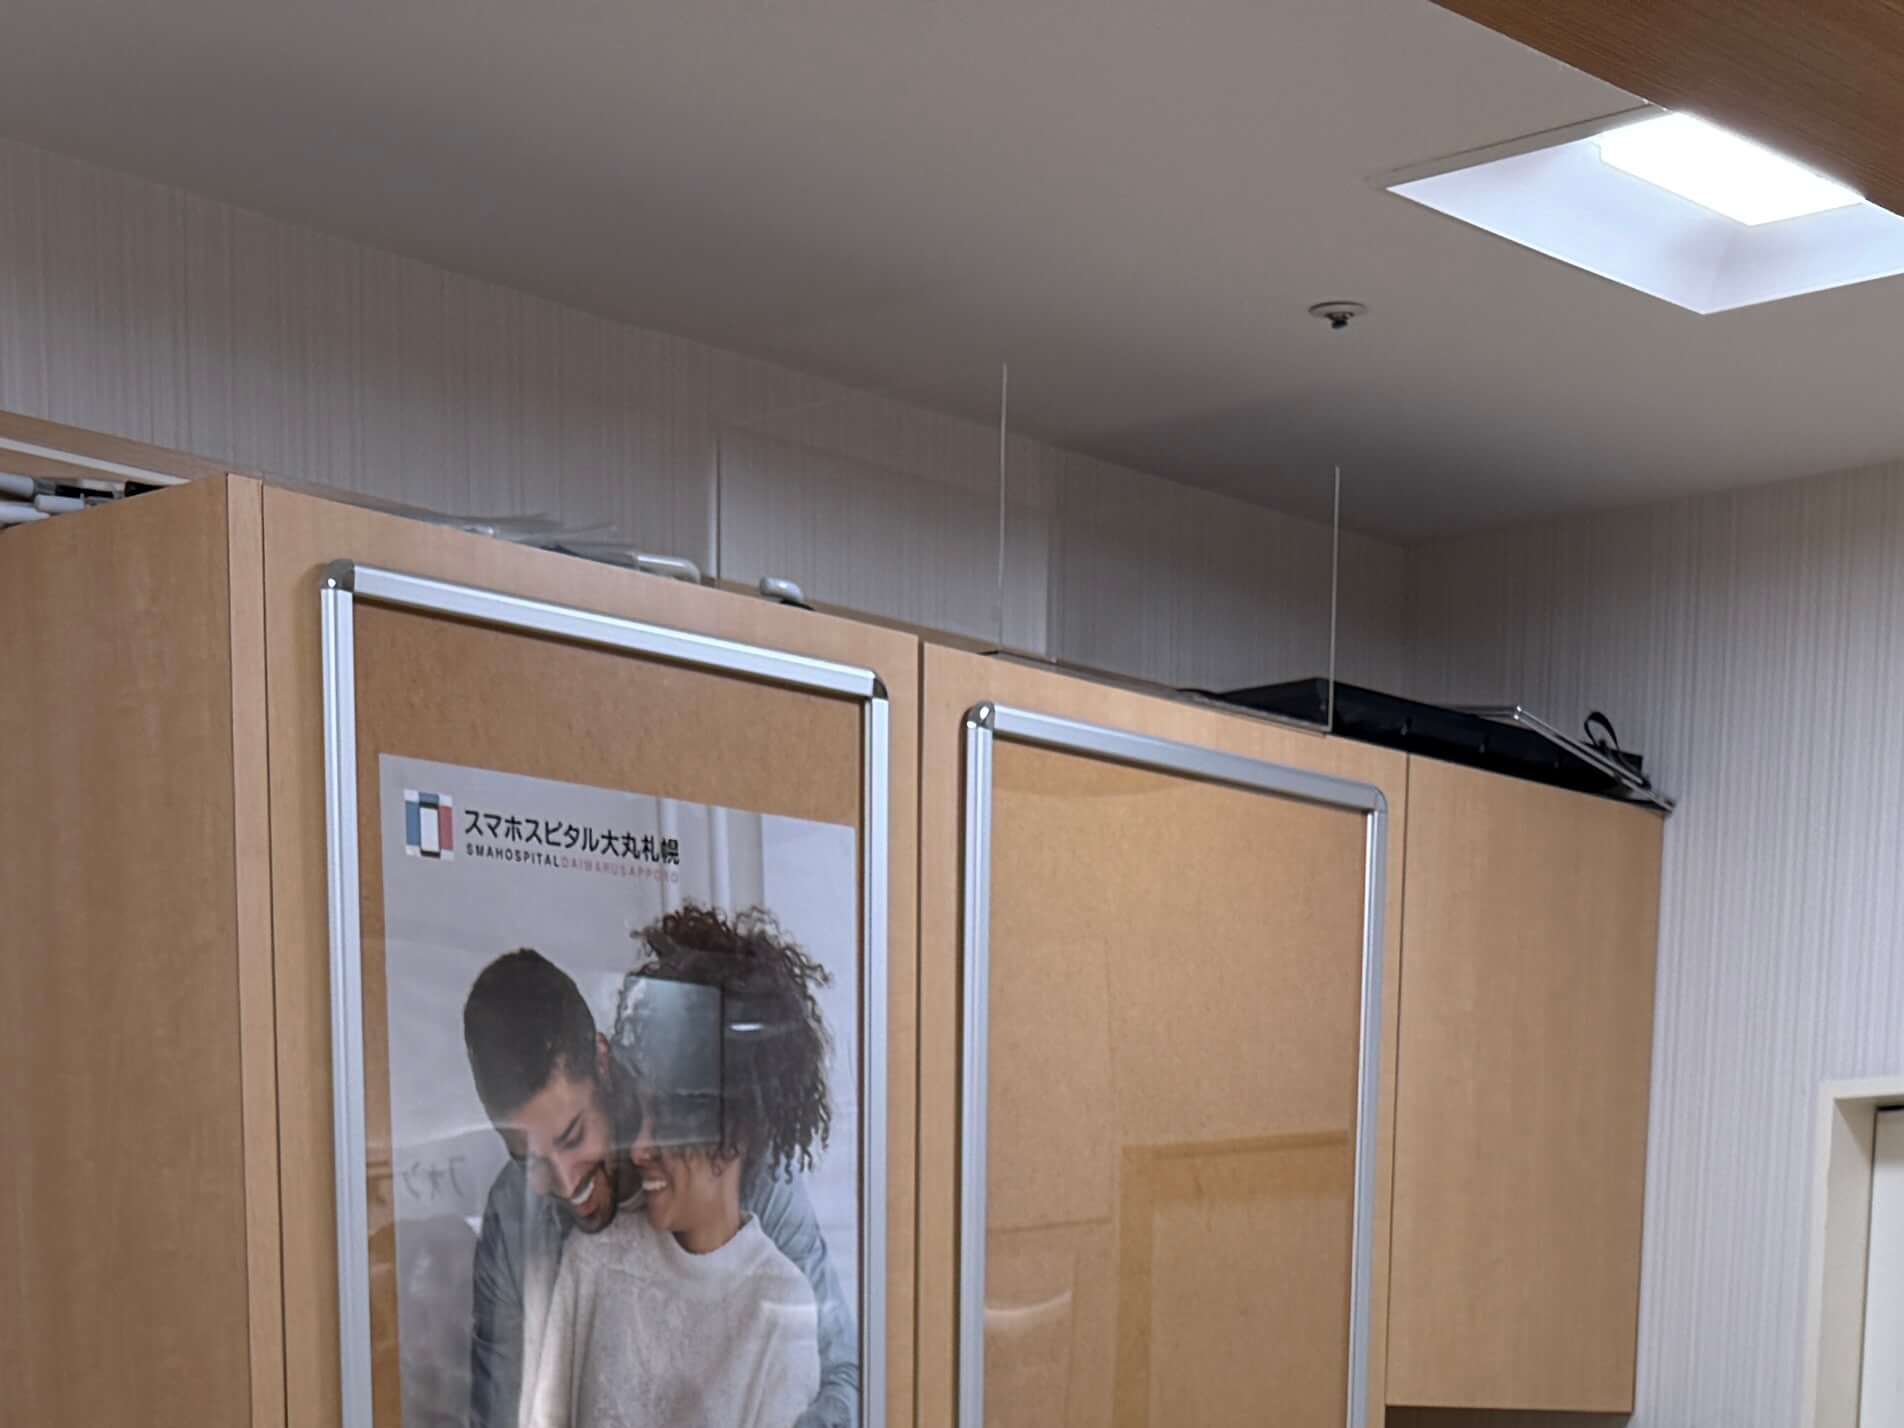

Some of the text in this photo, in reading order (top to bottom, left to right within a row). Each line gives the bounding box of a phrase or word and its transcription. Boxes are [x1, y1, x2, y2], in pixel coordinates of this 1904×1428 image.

[464, 809, 681, 866] スマホスピタル大丸札幌
